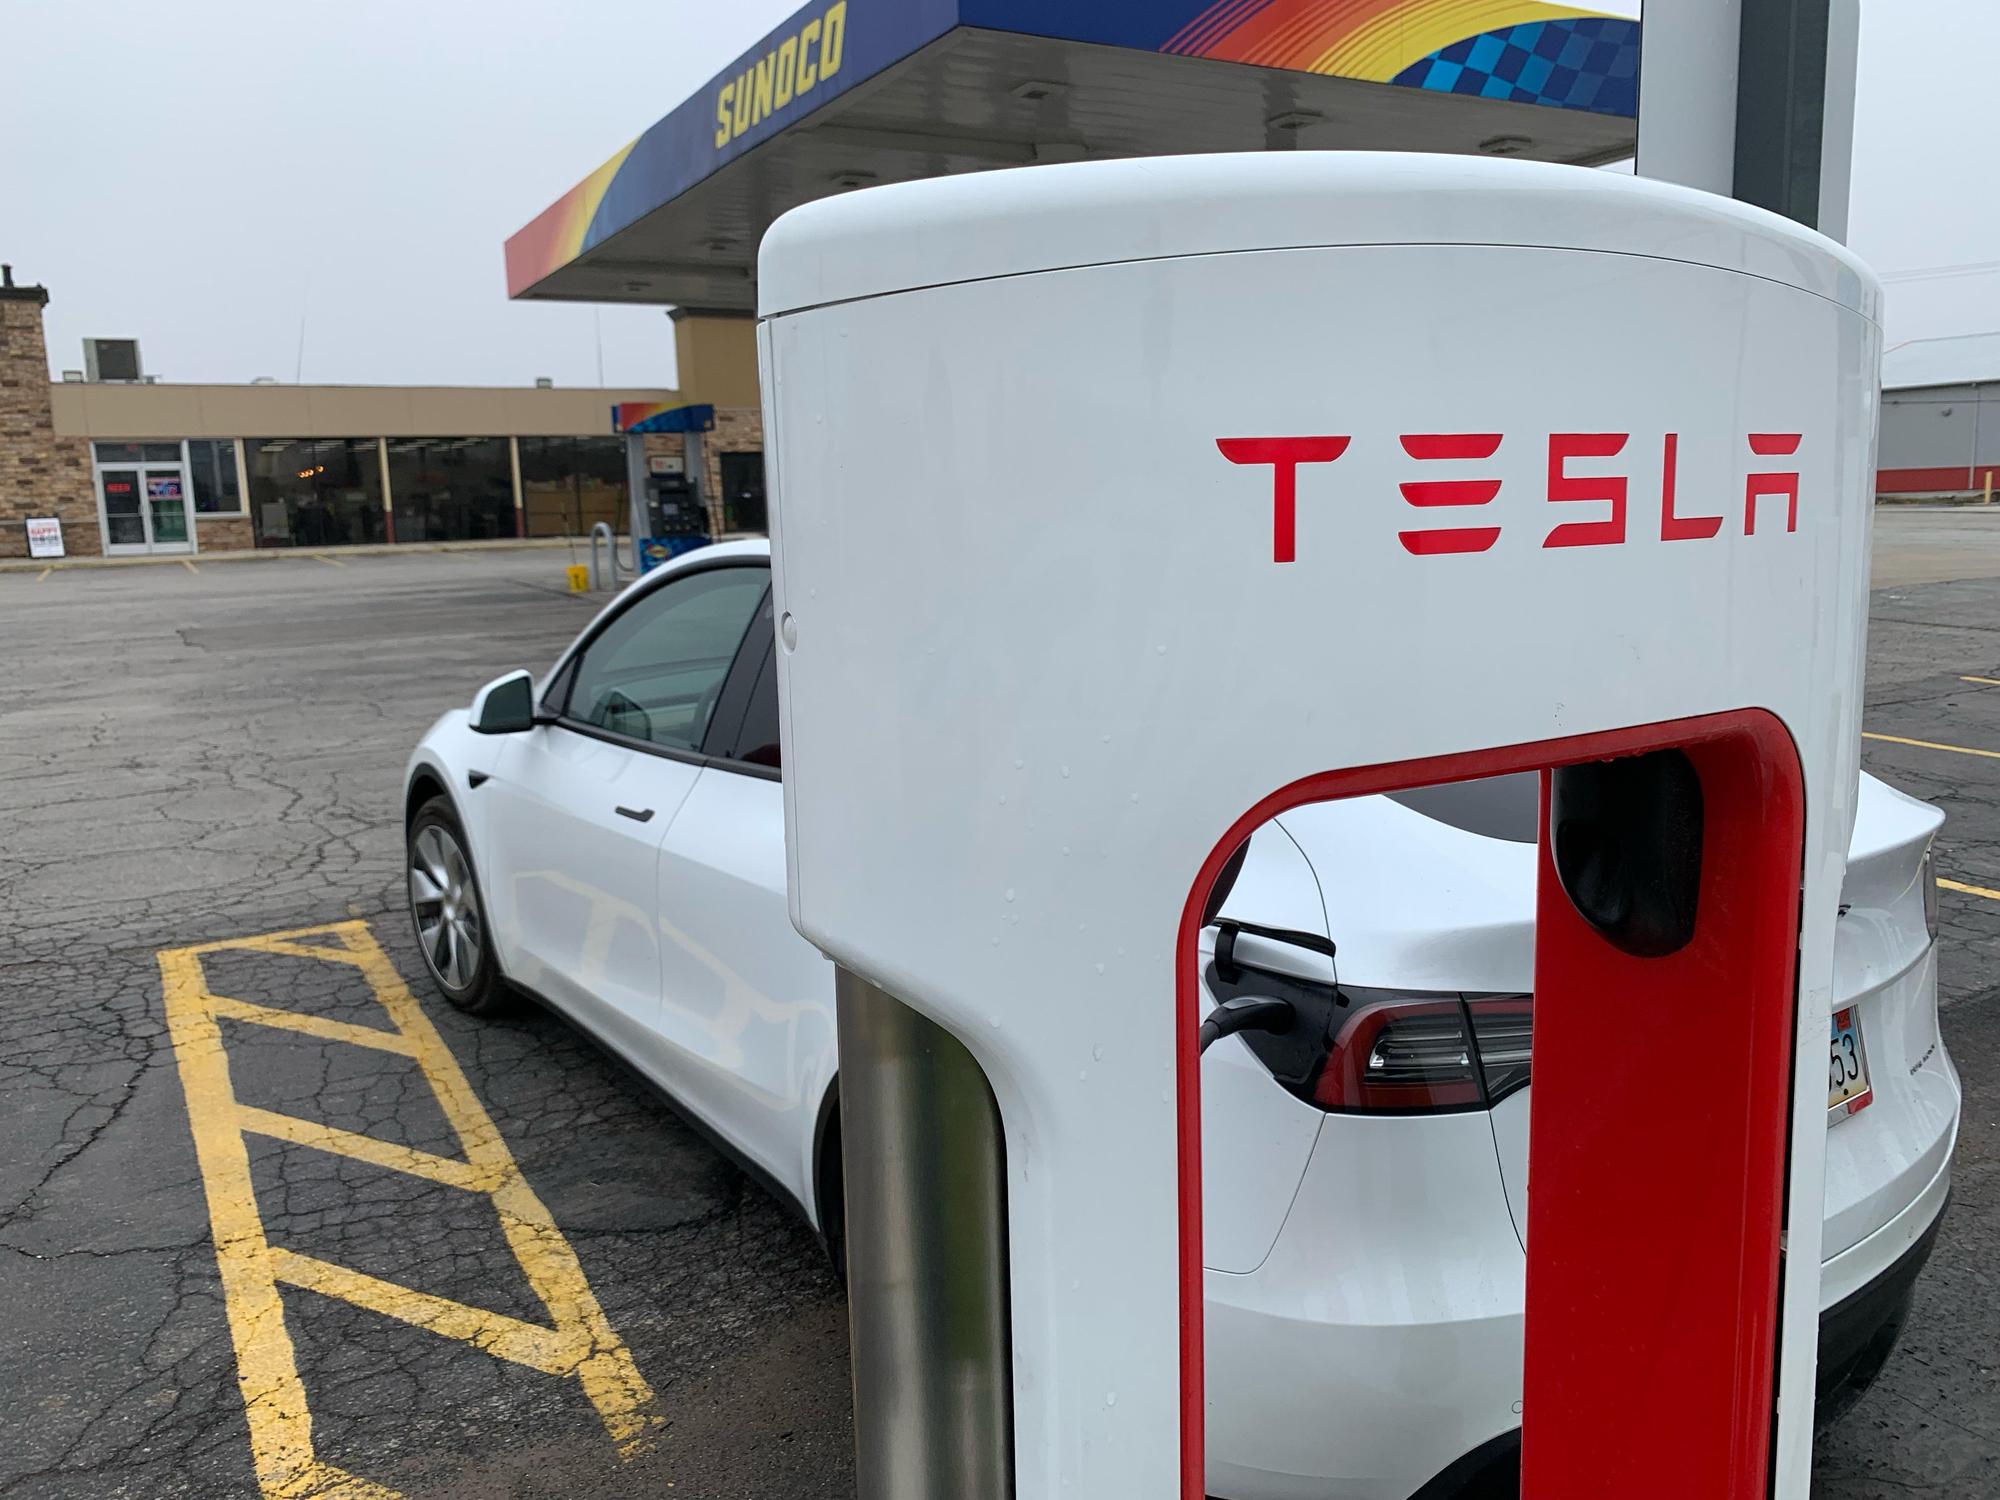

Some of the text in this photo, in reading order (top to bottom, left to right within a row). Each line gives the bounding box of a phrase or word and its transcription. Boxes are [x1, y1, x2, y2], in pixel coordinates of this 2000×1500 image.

[716, 1, 847, 150] SUNOCO
[1216, 433, 1802, 563] TESLA
[1829, 1033, 1859, 1092] 53
